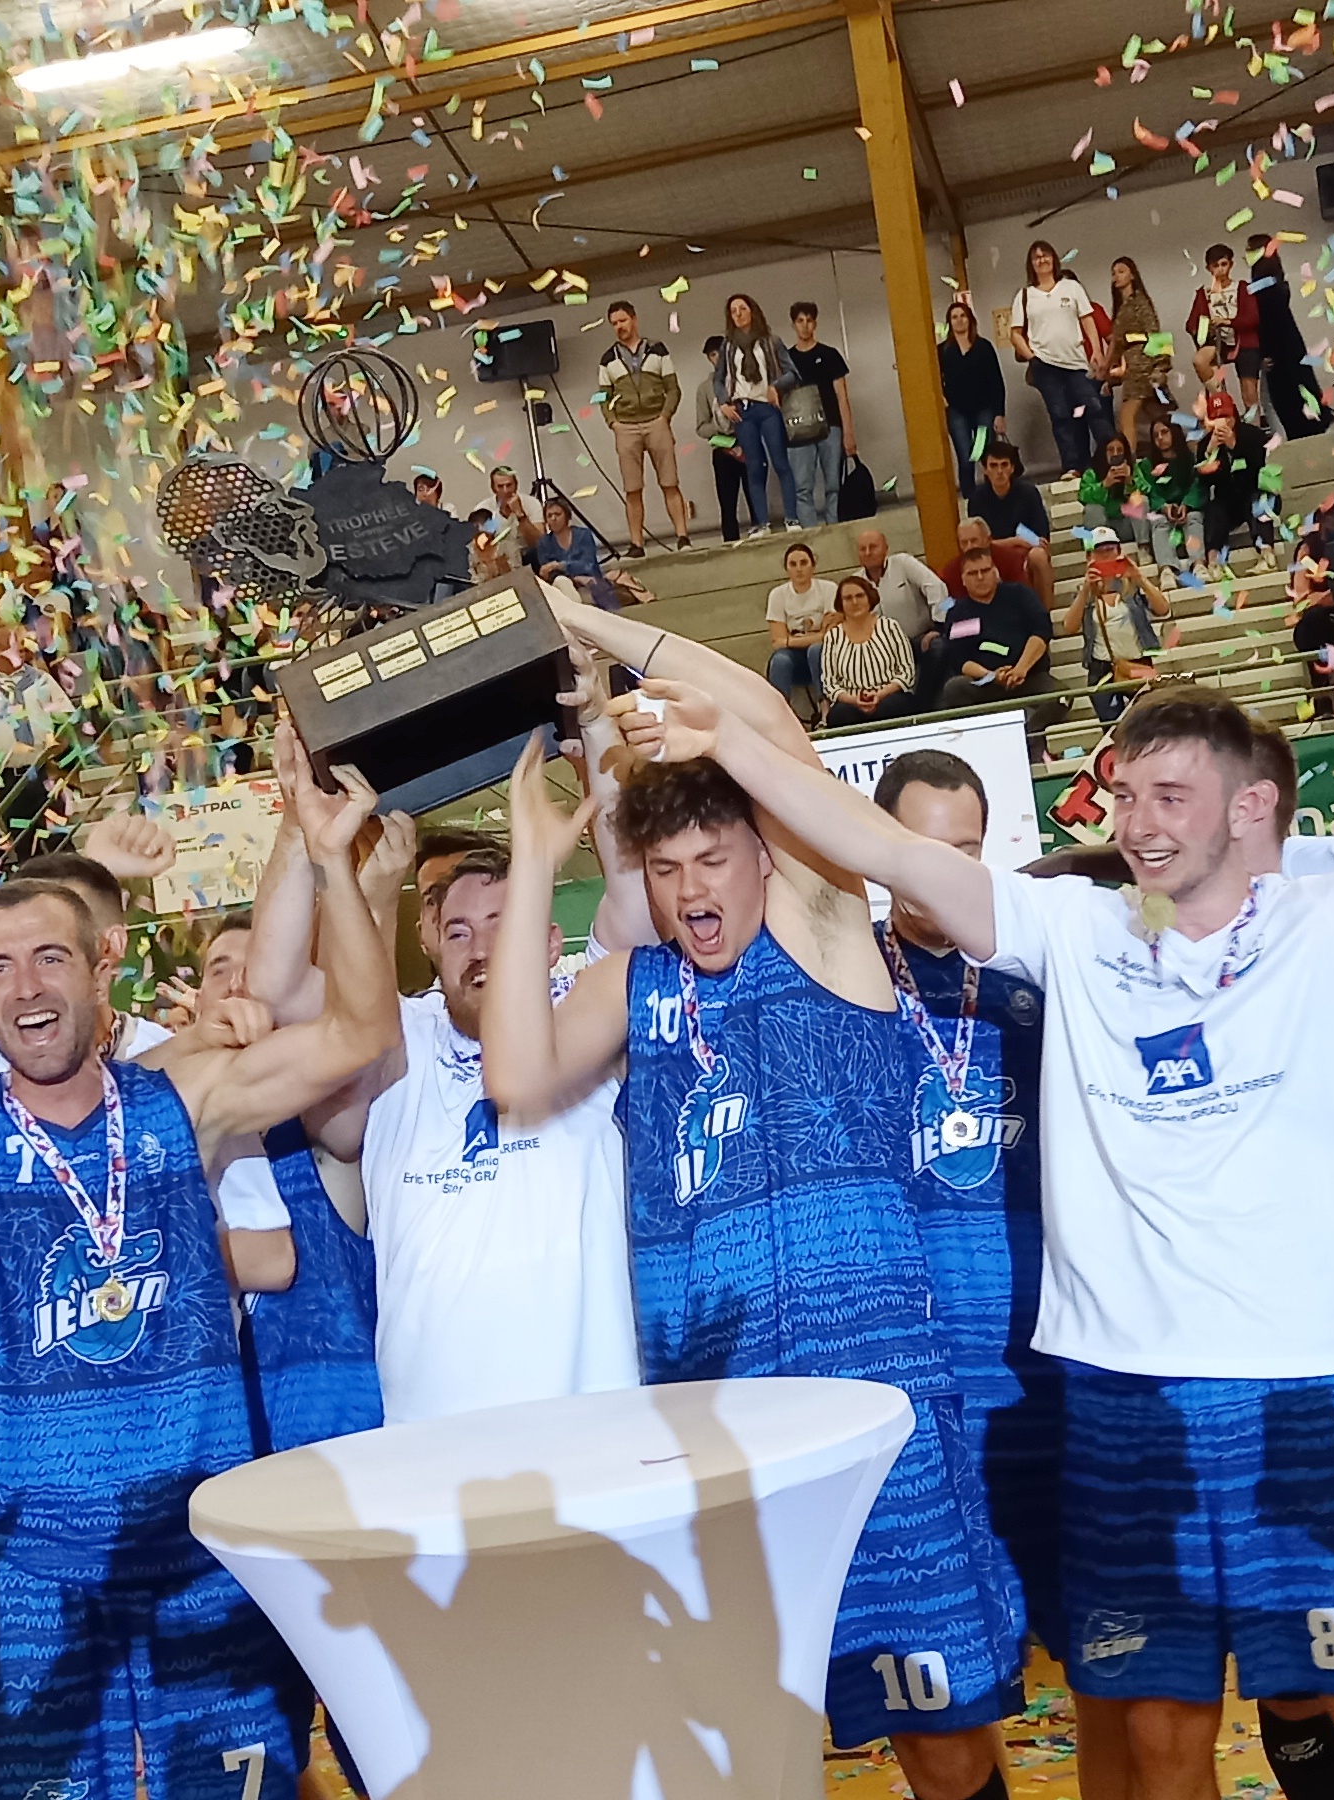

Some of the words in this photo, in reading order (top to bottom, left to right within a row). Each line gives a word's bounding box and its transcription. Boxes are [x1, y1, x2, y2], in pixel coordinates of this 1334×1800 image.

[645, 988, 682, 1044] 10
[1147, 1057, 1205, 1090] AXA
[4, 1134, 37, 1185] 7
[870, 1649, 952, 1713] 10
